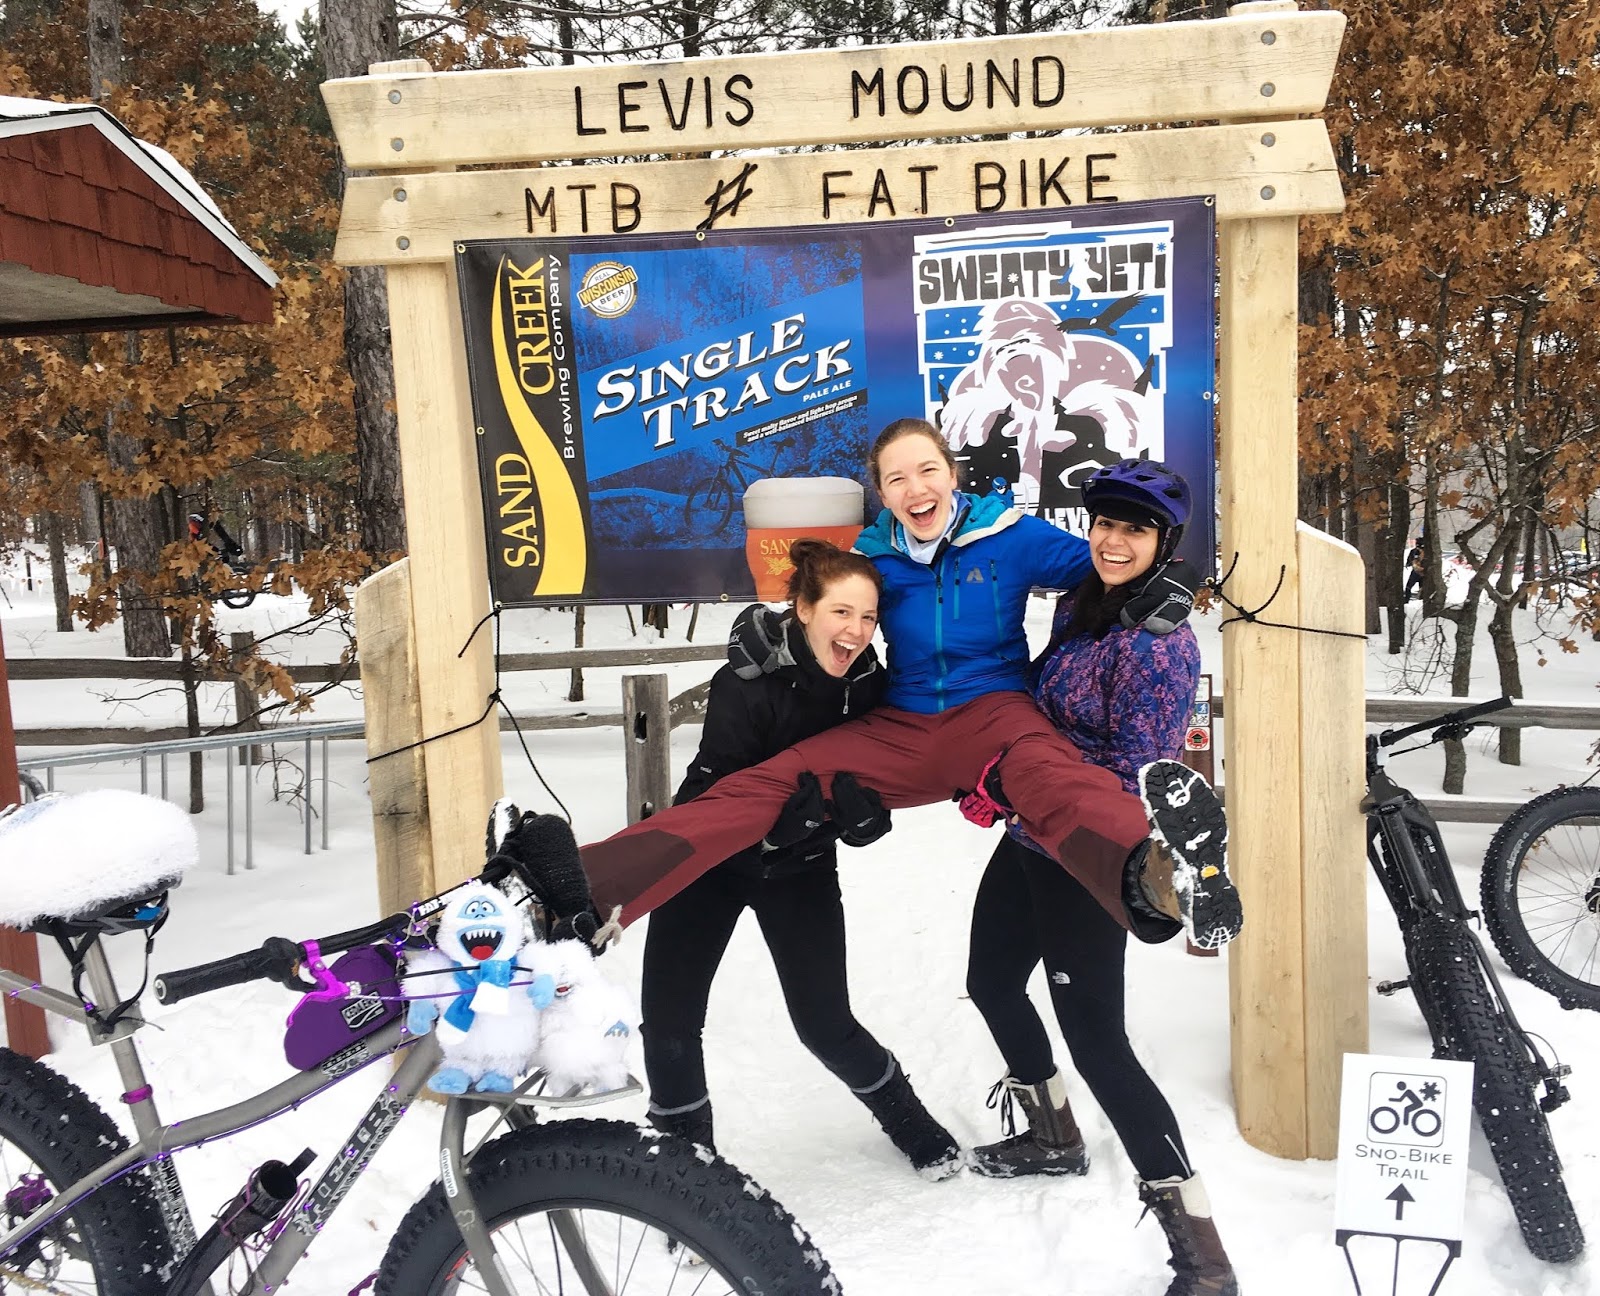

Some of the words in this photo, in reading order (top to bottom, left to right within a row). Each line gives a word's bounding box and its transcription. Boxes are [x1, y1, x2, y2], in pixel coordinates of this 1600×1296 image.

[575, 73, 754, 137] LEVIS
[851, 55, 1066, 118] MOUND
[525, 182, 642, 234] MTB
[822, 164, 939, 220] FAT
[974, 152, 1119, 213] BIKE
[549, 254, 566, 361] Company
[579, 268, 637, 305] WISCONSIN
[594, 271, 610, 282] REAL
[600, 289, 625, 305] BEER
[919, 249, 1071, 304] SWEATY
[507, 257, 555, 395] CREEK
[593, 312, 807, 423] SINGLE
[642, 339, 853, 447] TRACK
[802, 387, 829, 402] PALE
[831, 380, 851, 393] ALE
[558, 368, 575, 459] Brewing
[797, 410, 809, 421] and
[495, 453, 541, 568] SAND
[760, 538, 797, 555] SAN
[441, 1149, 456, 1196] sinewave
